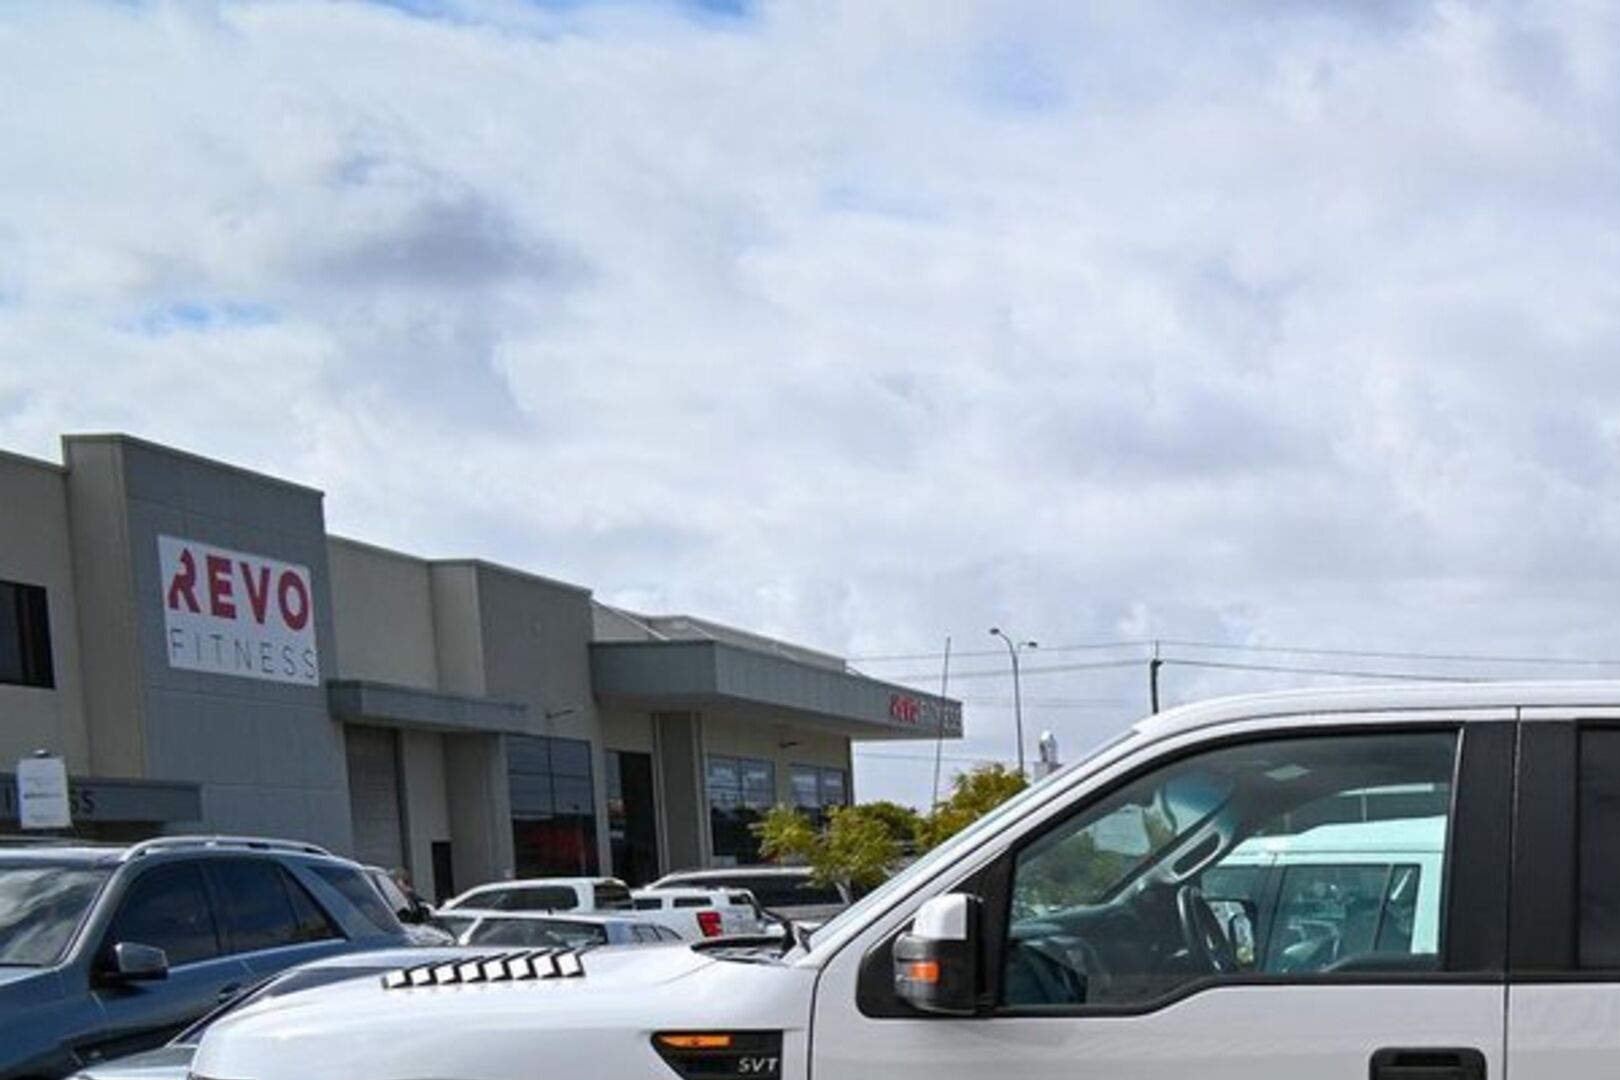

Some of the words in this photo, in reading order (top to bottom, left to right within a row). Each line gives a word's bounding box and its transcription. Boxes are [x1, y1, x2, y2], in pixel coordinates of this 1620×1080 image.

[167, 547, 310, 631] REVO
[170, 627, 319, 679] FITNESS
[738, 1057, 779, 1073] SVT
